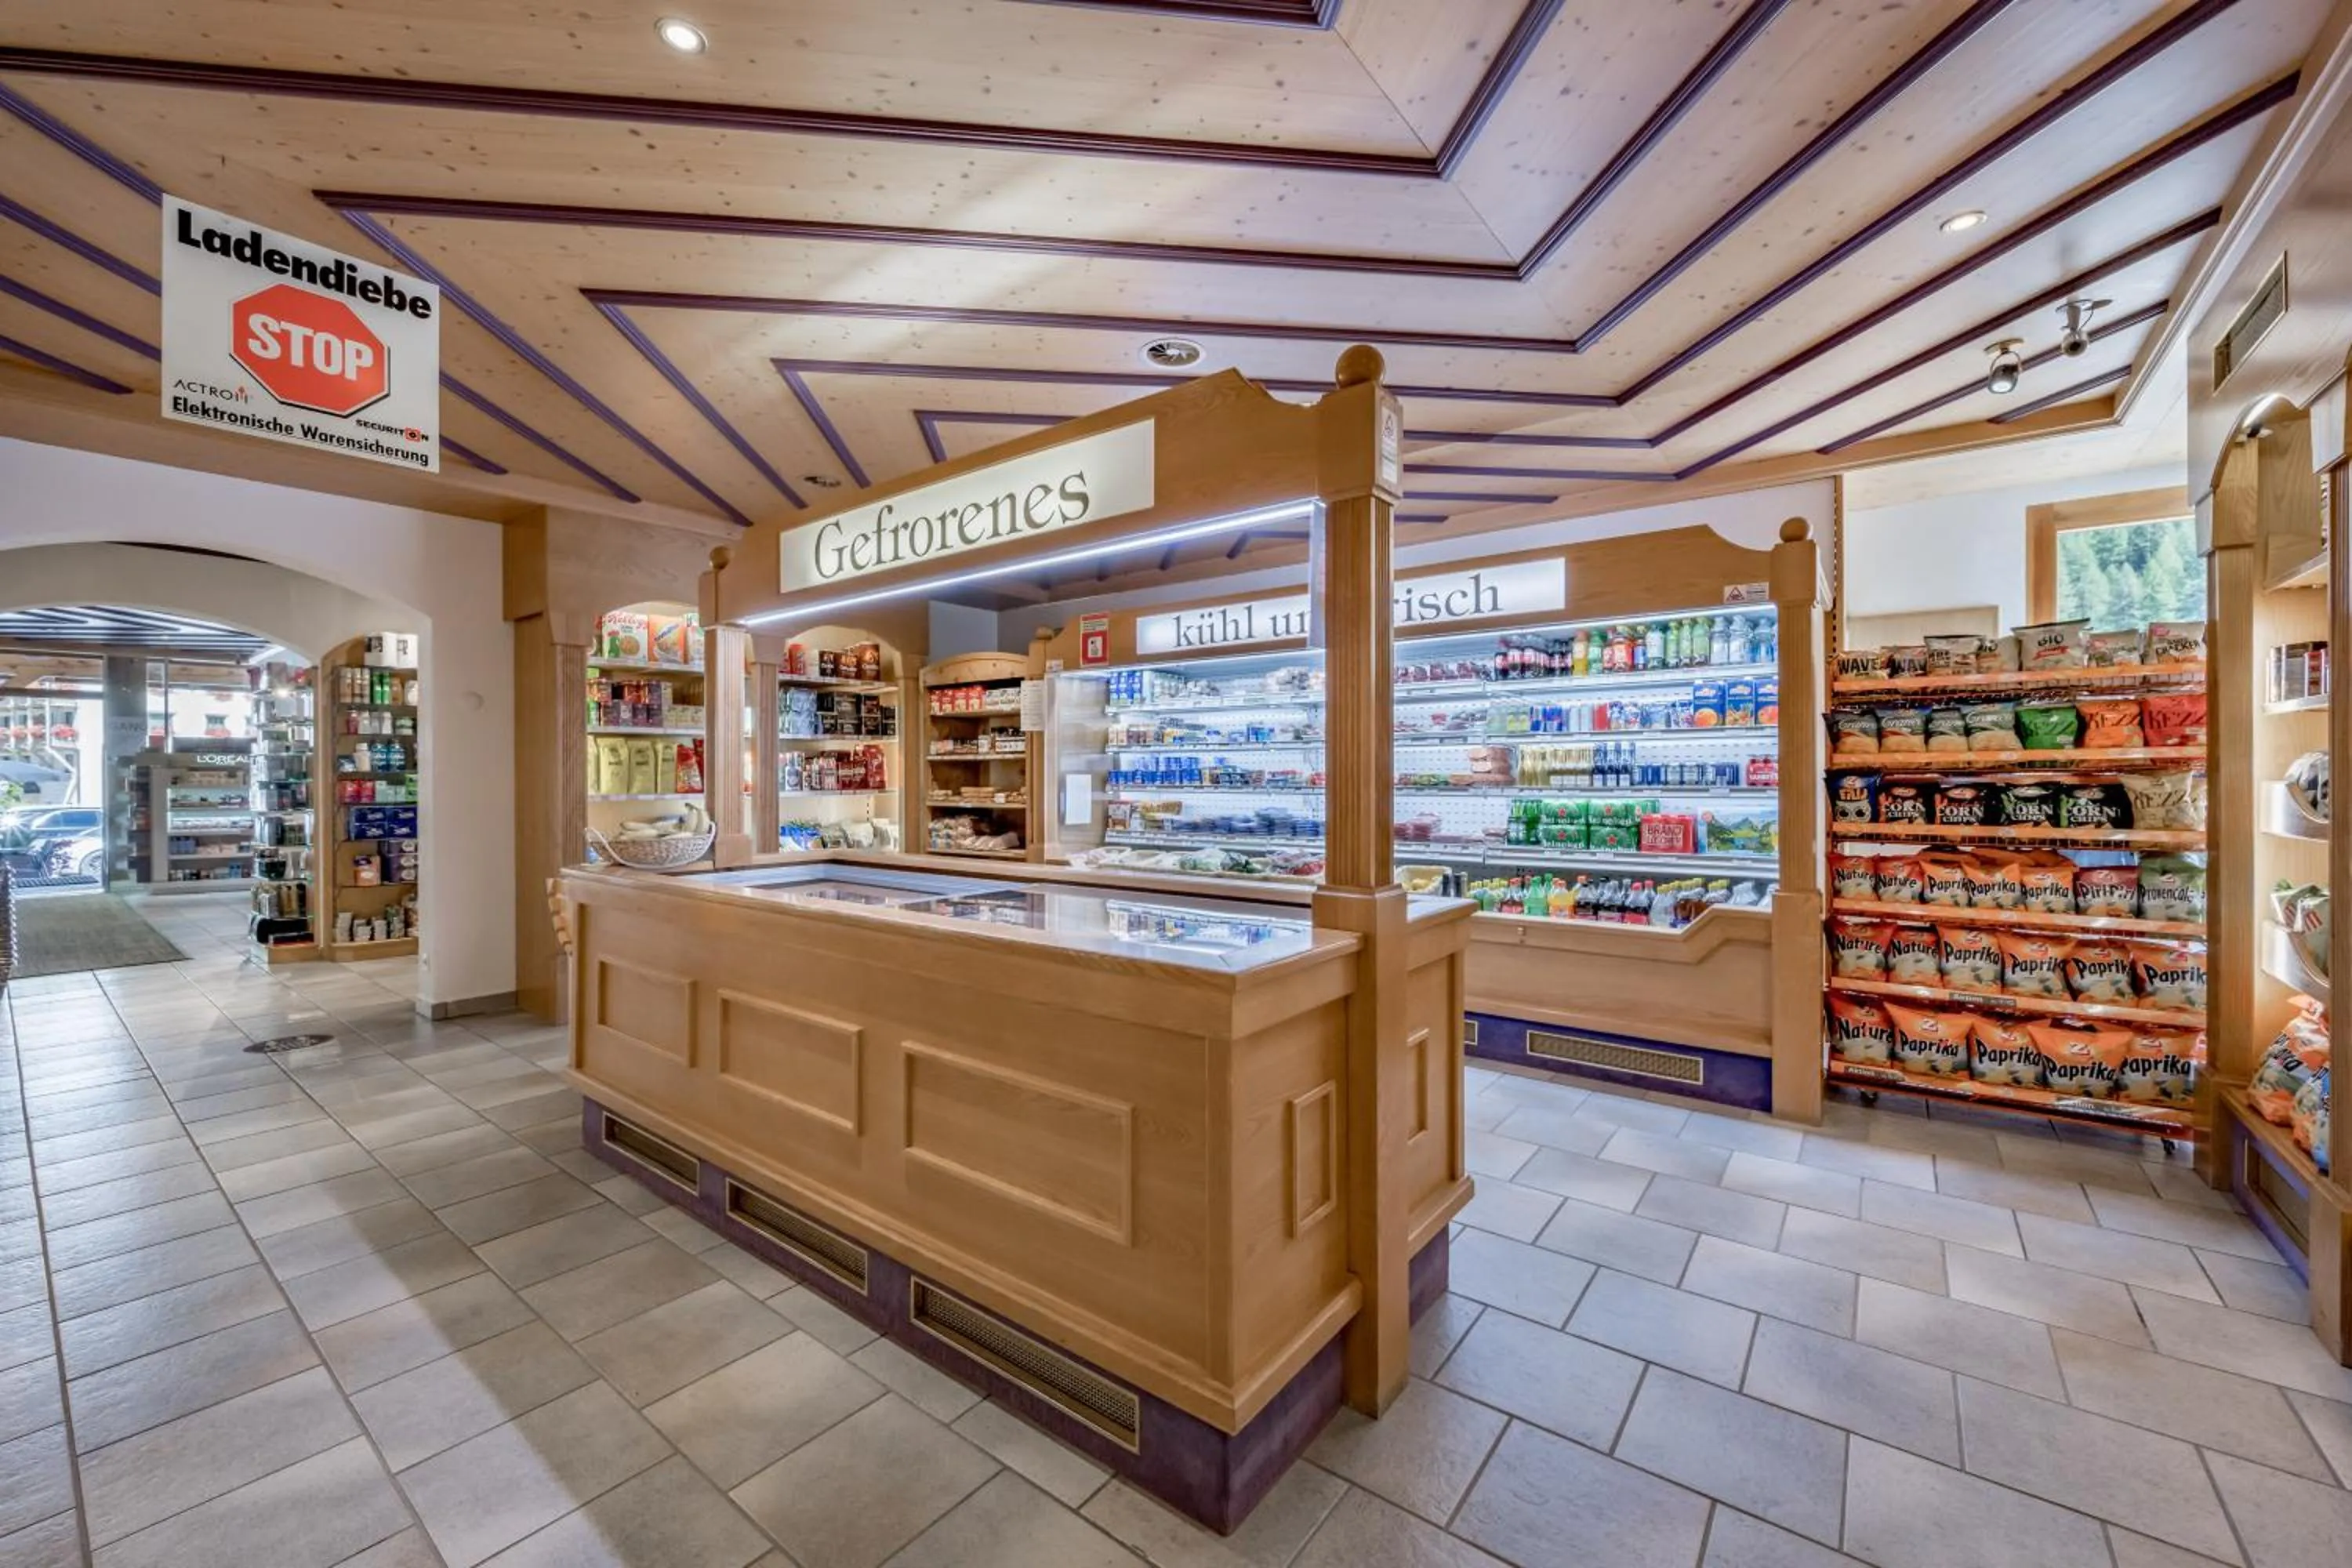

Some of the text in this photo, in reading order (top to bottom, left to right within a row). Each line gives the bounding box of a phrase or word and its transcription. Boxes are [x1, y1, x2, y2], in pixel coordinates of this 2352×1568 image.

[177, 208, 432, 319] Ladendiebe
[248, 313, 374, 381] STOP
[172, 396, 429, 467] Elektronische Warensicherung
[355, 418, 429, 442] SECURITON
[815, 470, 1091, 579] Gefrorenes
[1173, 604, 1257, 648] kühl
[1394, 572, 1504, 622] isch
[1882, 800, 1926, 812] CORN
[1936, 804, 1984, 817] CORN
[2063, 806, 2116, 817] CORN
[1835, 867, 1875, 885] Nature
[1878, 873, 1917, 889] Nature
[1969, 877, 2017, 898] Paprika
[2020, 882, 2069, 900] Paprika
[1836, 935, 1882, 954] Nature
[1891, 940, 1939, 958] Nature
[1944, 940, 2000, 964] Paprika
[2143, 964, 2207, 985] Paprik
[1836, 1017, 1893, 1041] Nature
[1898, 1028, 1959, 1058] Paprika
[1975, 1037, 2043, 1067] Paprika
[2043, 1054, 2117, 1081] Paprika
